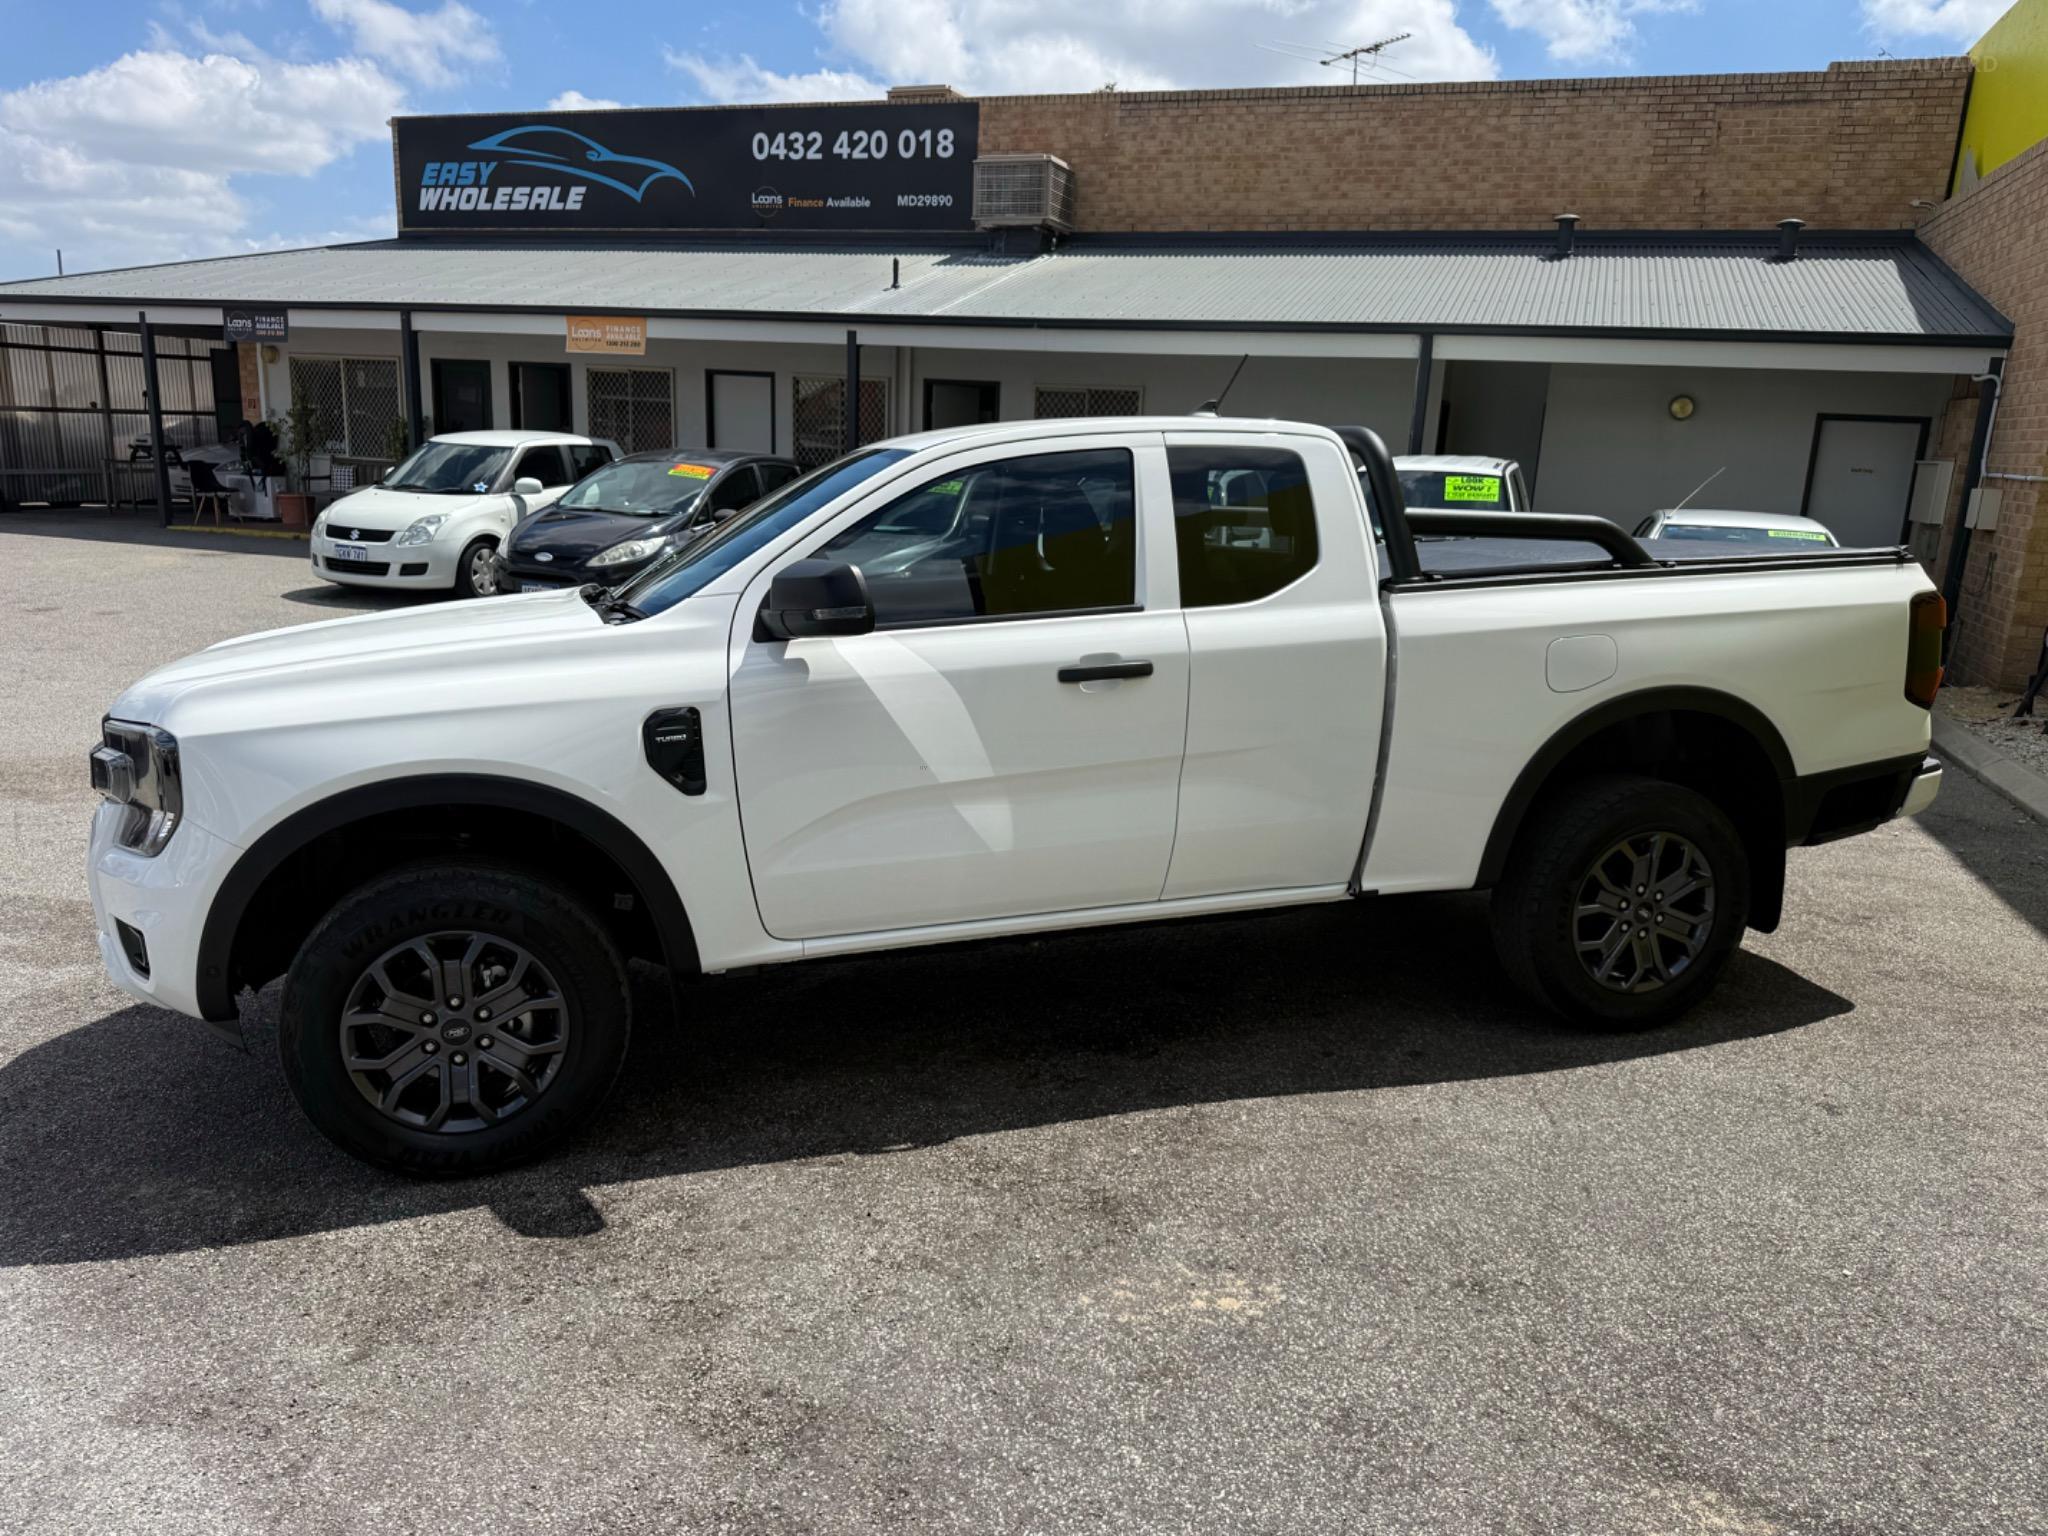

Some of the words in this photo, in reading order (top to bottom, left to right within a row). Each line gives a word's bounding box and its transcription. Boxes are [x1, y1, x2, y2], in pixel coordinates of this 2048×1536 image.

[752, 131, 823, 160] 0432
[832, 130, 888, 159] 420
[897, 128, 954, 159] 018
[421, 161, 498, 186] EASY
[419, 186, 587, 211] WHOLESALE
[752, 192, 783, 204] Loans
[788, 197, 824, 208] Finance
[826, 197, 871, 208] Available
[897, 195, 953, 207] MD29890
[227, 316, 252, 327] Loans
[571, 326, 601, 337] Loans
[606, 325, 640, 333] FINANCE
